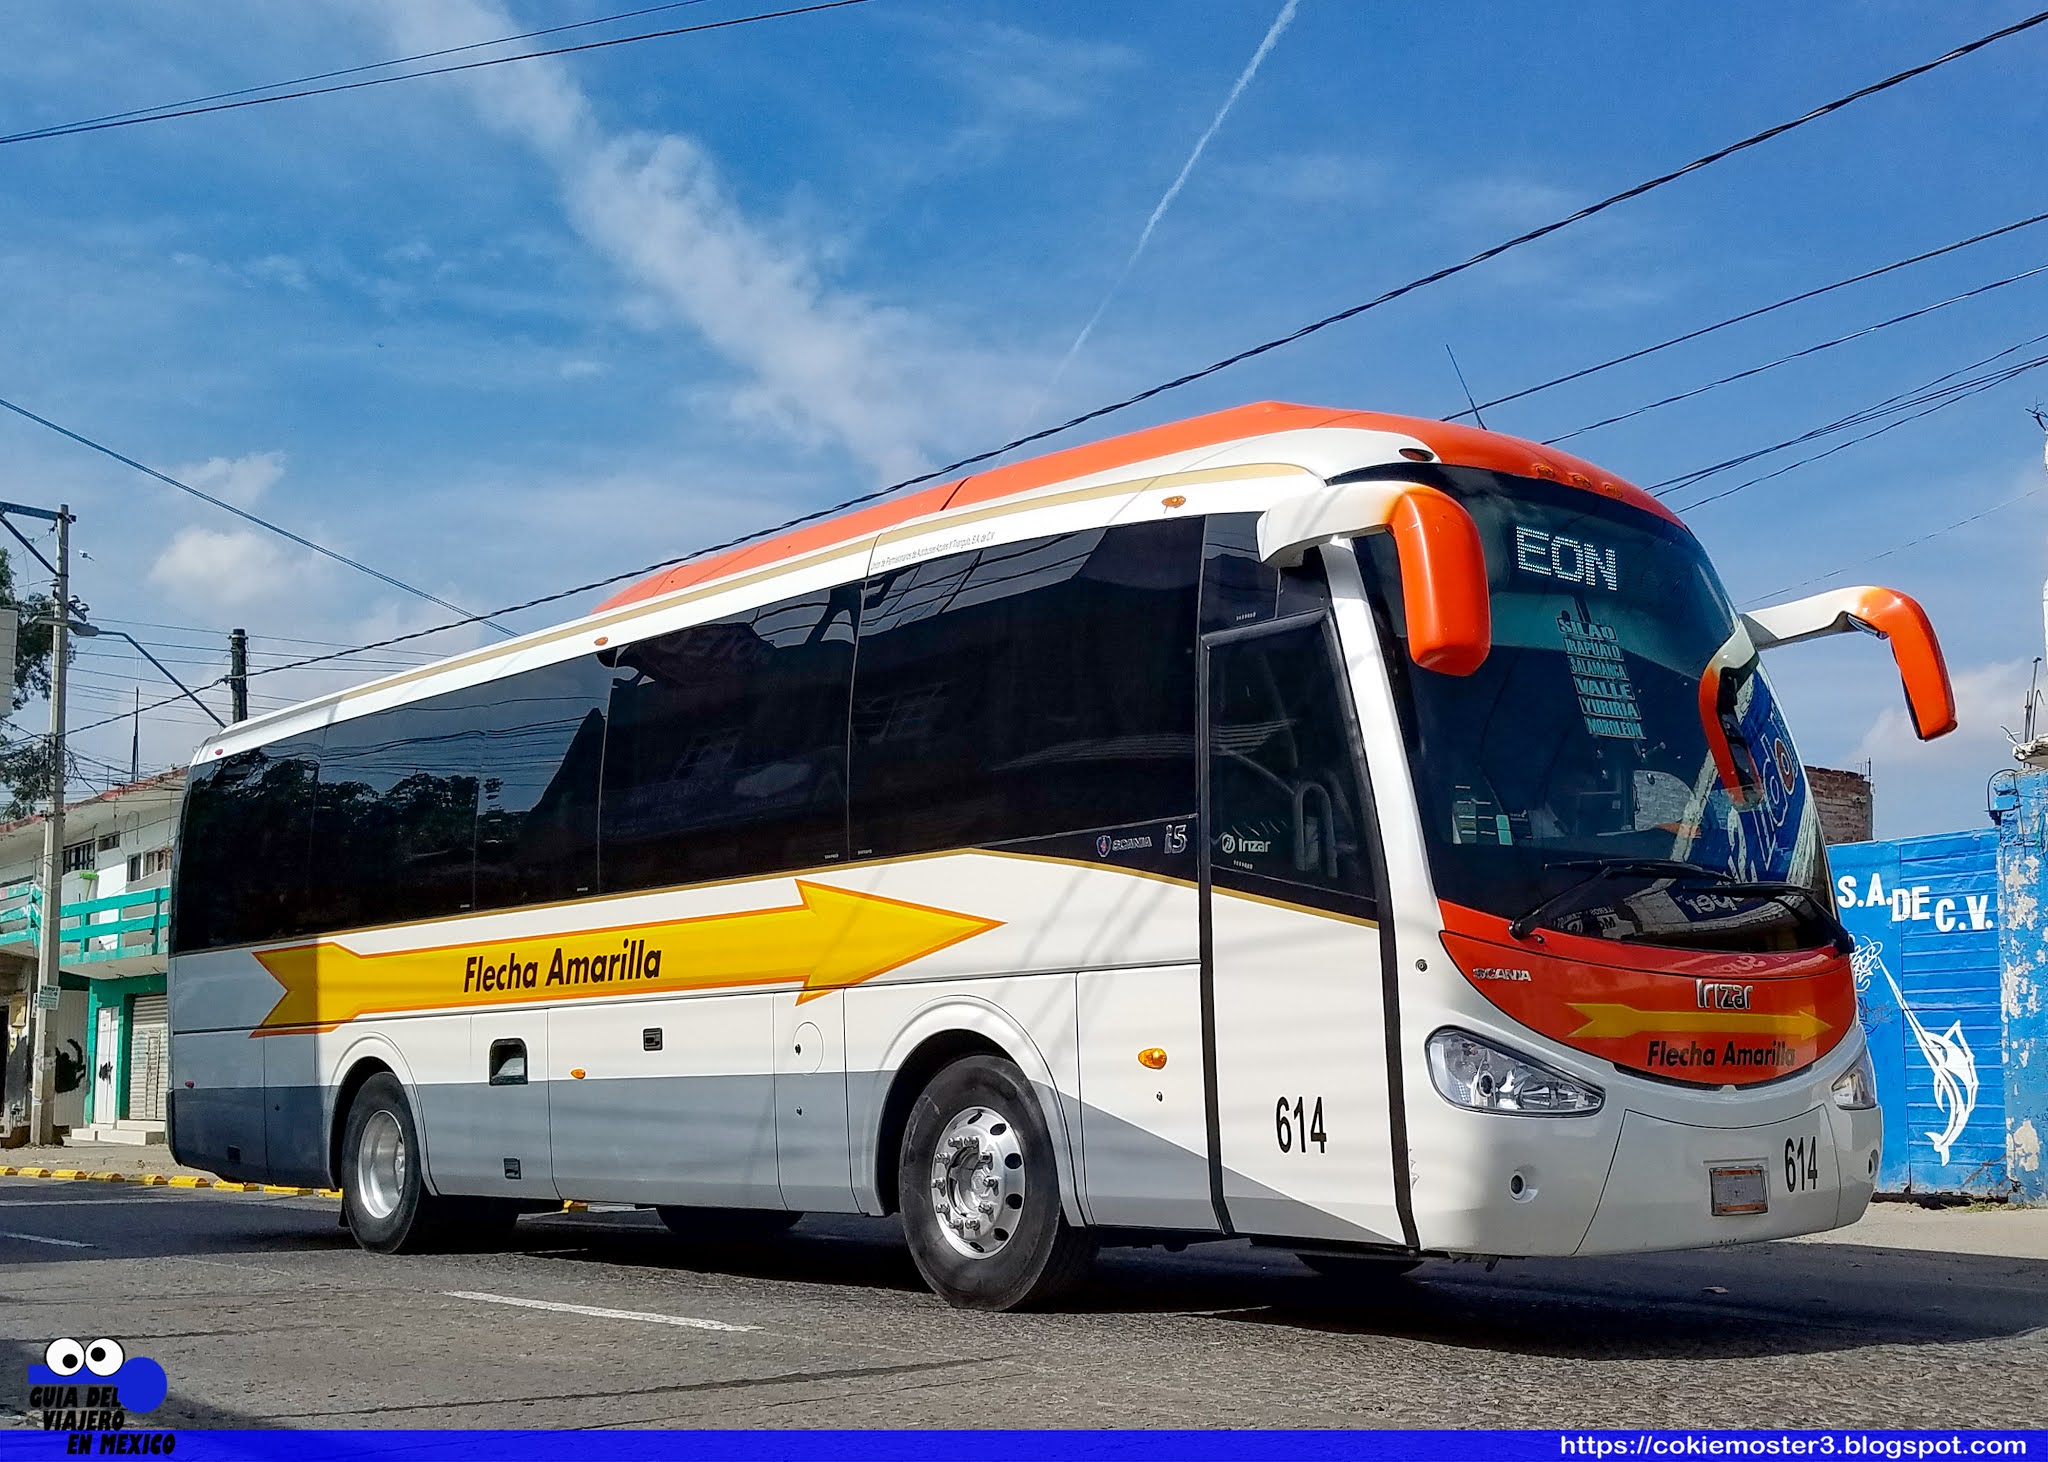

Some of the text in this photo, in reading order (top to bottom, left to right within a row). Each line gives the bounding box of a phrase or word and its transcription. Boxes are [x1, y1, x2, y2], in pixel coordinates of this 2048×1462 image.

[1516, 526, 1617, 591] EON
[1558, 619, 1617, 640] SILAO
[1564, 638, 1621, 658] IRAPUATO
[1570, 658, 1627, 678] SALAMANCA
[1574, 678, 1633, 699] VALLE
[1581, 698, 1638, 717] YURIRIA
[1112, 824, 1188, 854] SCANIA i5
[1238, 838, 1271, 853] Irizar
[1837, 873, 1994, 932] S.A. DE C.V.
[464, 938, 662, 992] Flecha Amarilla
[1473, 968, 1532, 981] SCANIA
[1695, 979, 1753, 1010] Irizar
[1647, 1040, 1796, 1066] Flecha Amarilla
[1276, 1096, 1327, 1153] 614
[1785, 1136, 1818, 1192] 614
